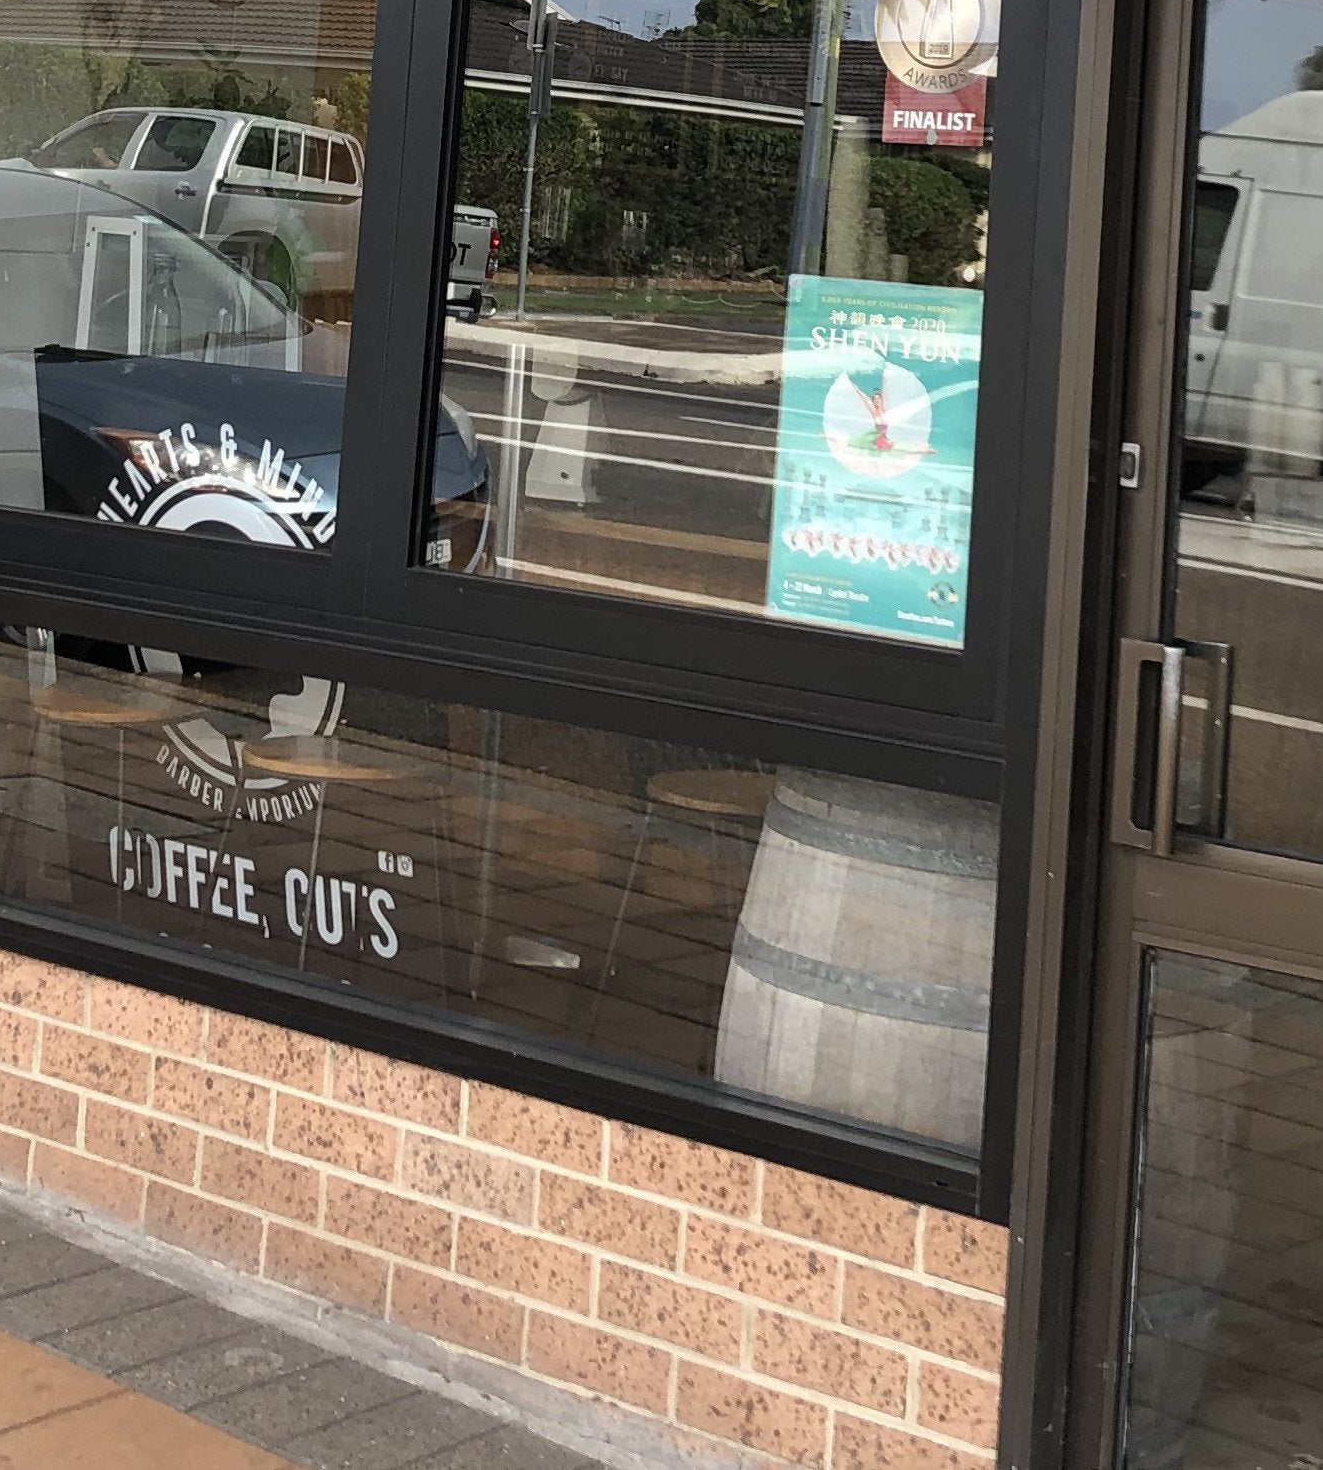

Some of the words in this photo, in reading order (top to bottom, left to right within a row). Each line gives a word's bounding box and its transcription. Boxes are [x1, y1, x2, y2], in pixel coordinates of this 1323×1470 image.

[903, 66, 968, 90] AWARDS
[893, 110, 977, 131] FINALIST
[911, 317, 947, 333] 2020
[810, 326, 890, 357] SHEN
[900, 334, 963, 365] YUN
[220, 422, 238, 467] &
[155, 744, 223, 813] BARBER
